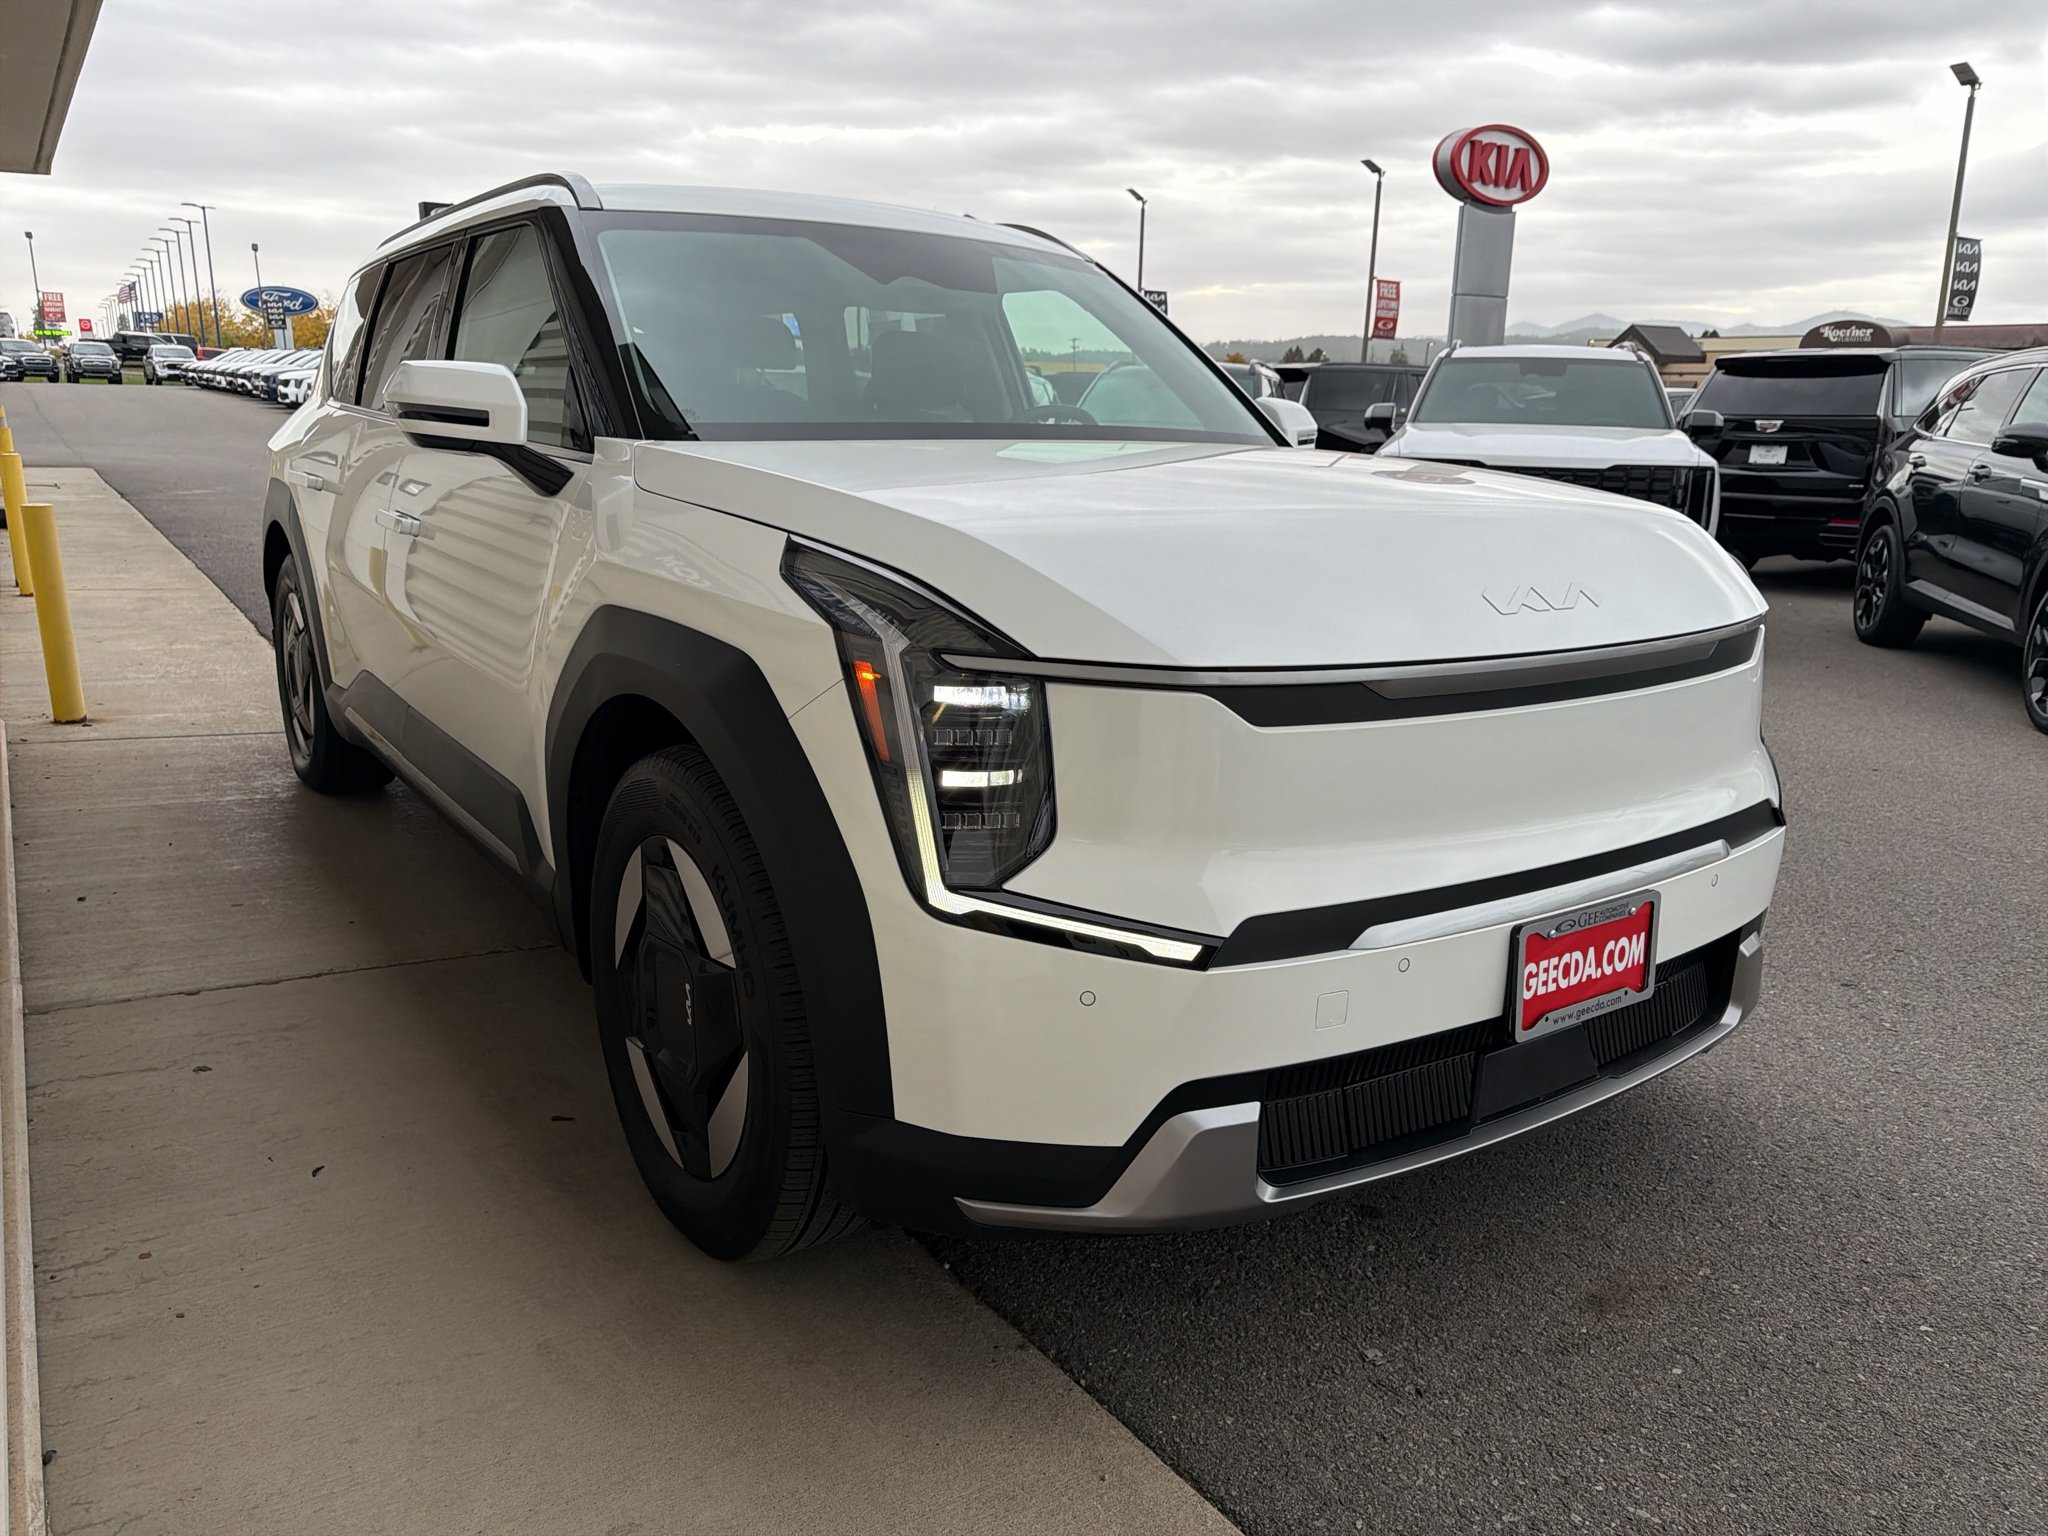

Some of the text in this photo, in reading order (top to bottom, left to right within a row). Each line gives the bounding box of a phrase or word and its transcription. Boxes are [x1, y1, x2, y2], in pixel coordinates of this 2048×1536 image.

[1467, 139, 1532, 191] KIA
[44, 293, 62, 301] FREE
[258, 291, 303, 310] Frd
[1380, 283, 1398, 299] FREE
[1820, 325, 1873, 343] Koerner
[1523, 932, 1645, 1000] GEECDA.COM
[1553, 995, 1622, 1025] www.geecda.com
